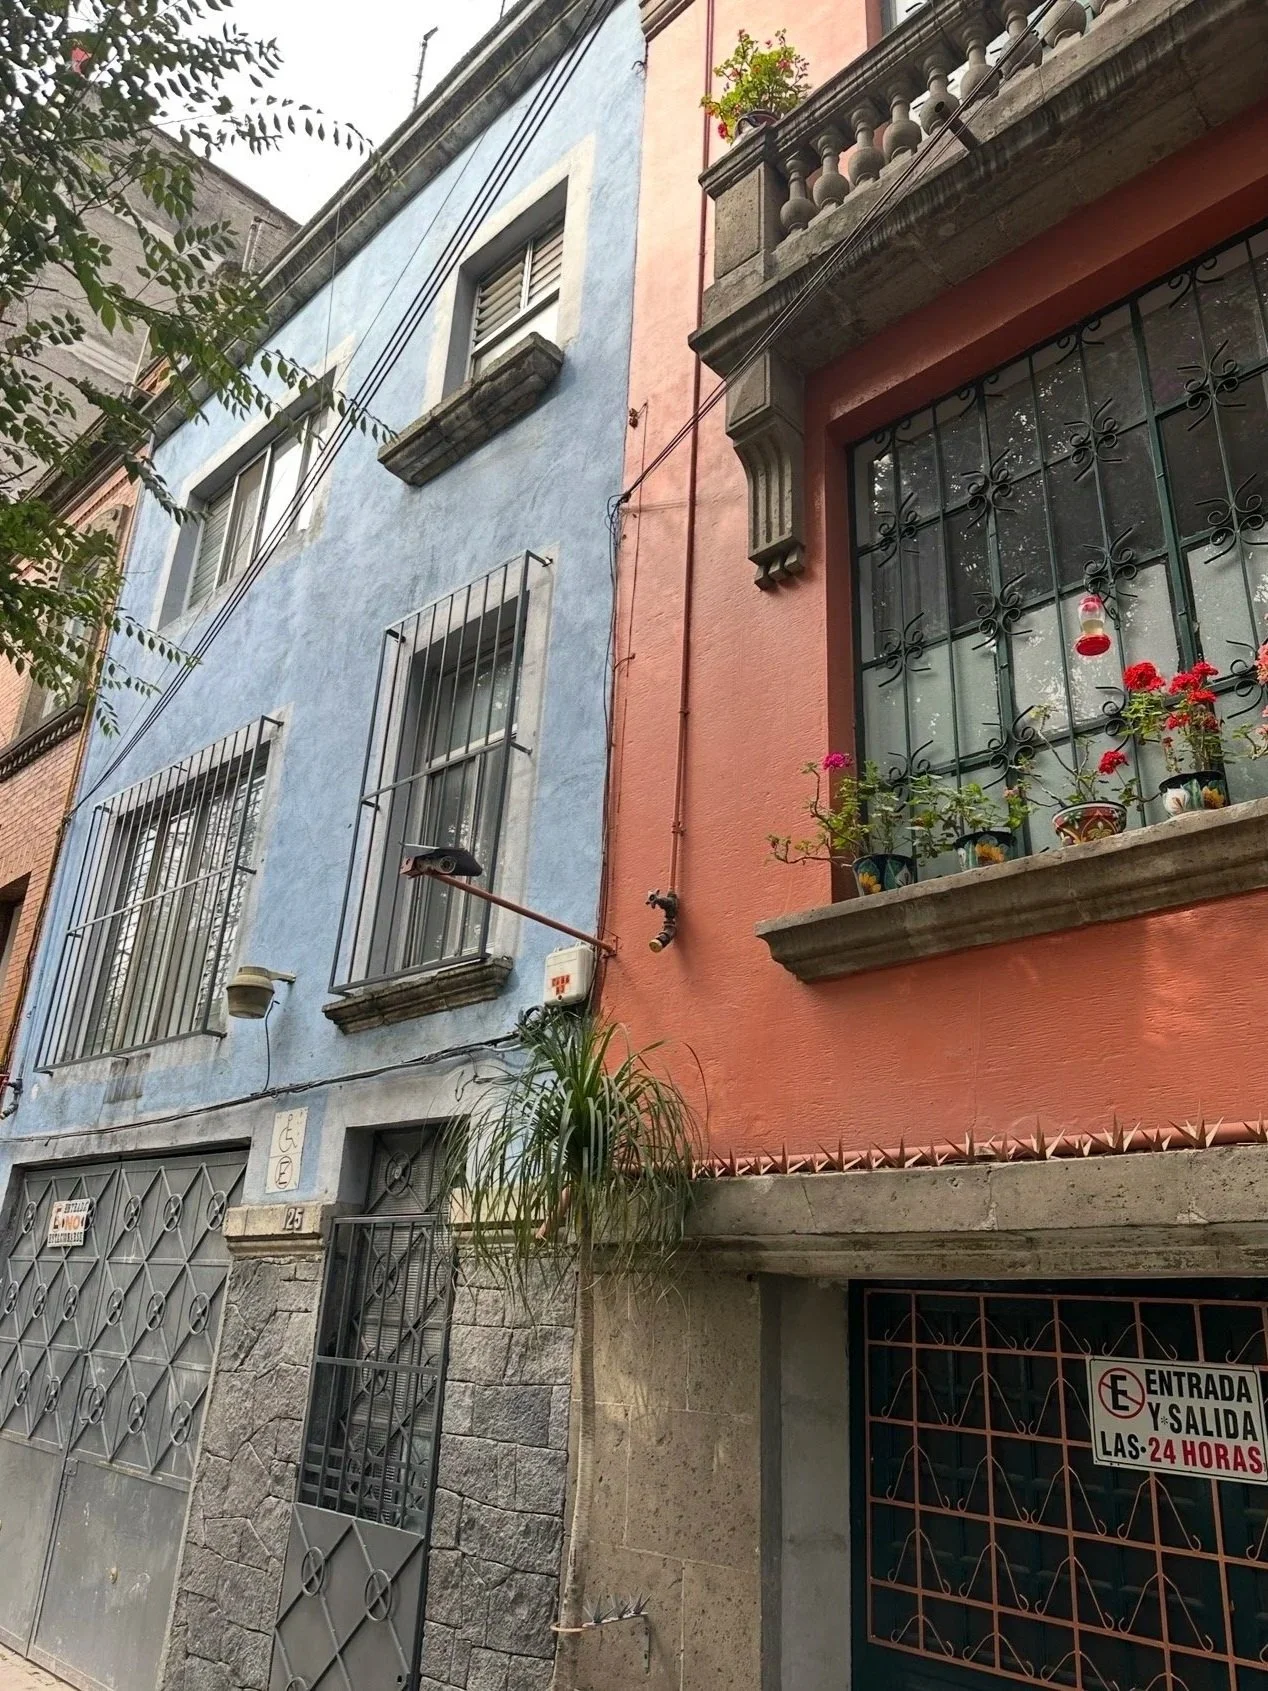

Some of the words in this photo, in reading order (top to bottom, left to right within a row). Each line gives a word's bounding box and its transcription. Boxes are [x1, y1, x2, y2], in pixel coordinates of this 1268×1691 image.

[64, 1215, 80, 1230] NO
[1110, 1374, 1129, 1411] E
[1145, 1369, 1253, 1403] ENTRADA
[1168, 1403, 1258, 1441] SALIDA
[1100, 1431, 1140, 1460] LAS
[1148, 1436, 1176, 1464] 24
[1181, 1439, 1263, 1474] HORAS
